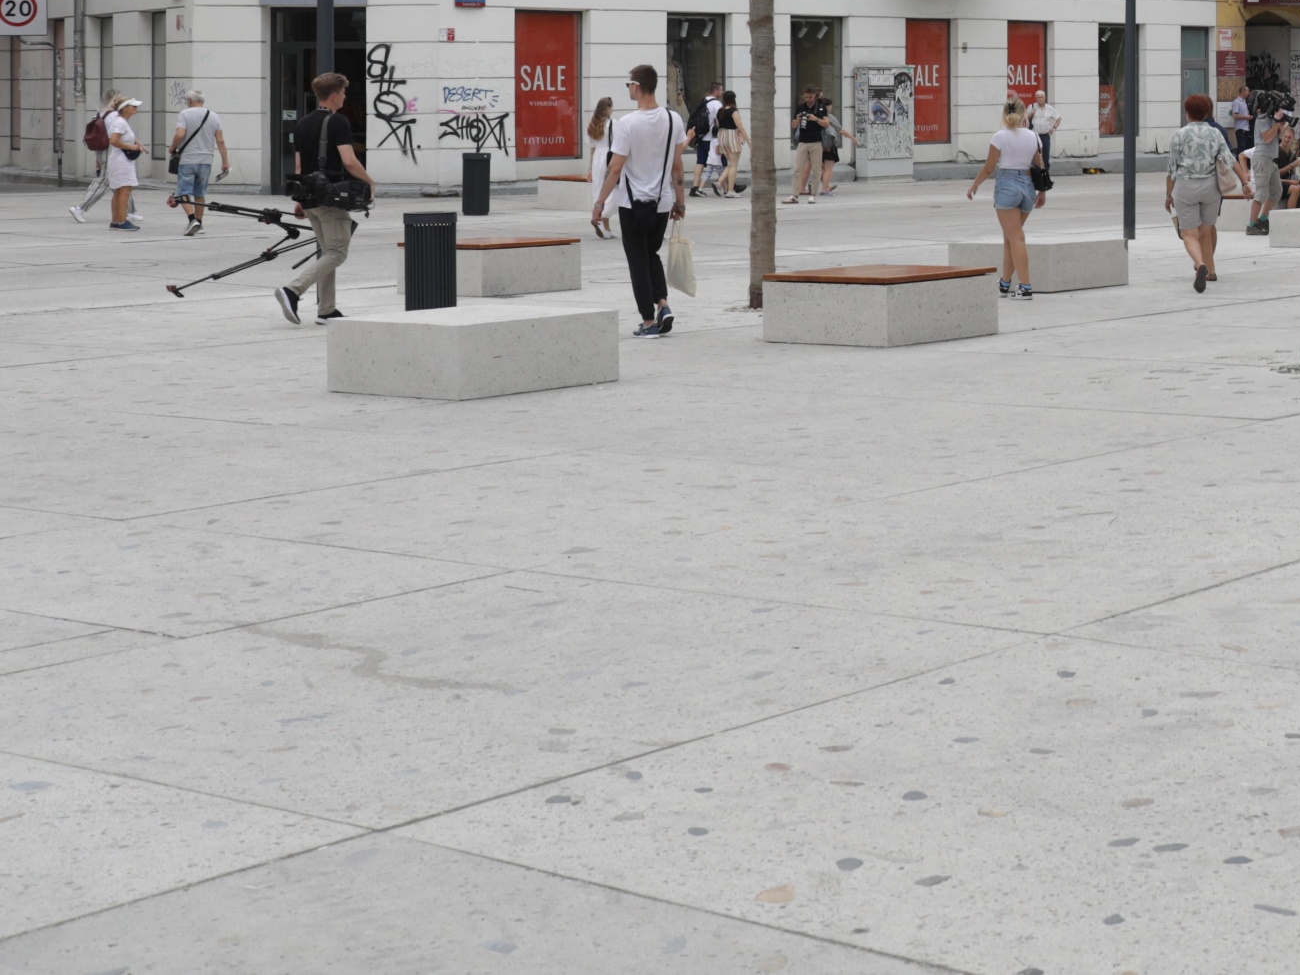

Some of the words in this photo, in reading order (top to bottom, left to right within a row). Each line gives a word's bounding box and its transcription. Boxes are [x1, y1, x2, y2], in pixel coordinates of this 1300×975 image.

[5, 0, 32, 17] 20
[520, 65, 566, 91] SALE
[914, 65, 939, 86] ALE
[1008, 65, 1038, 85] SALE
